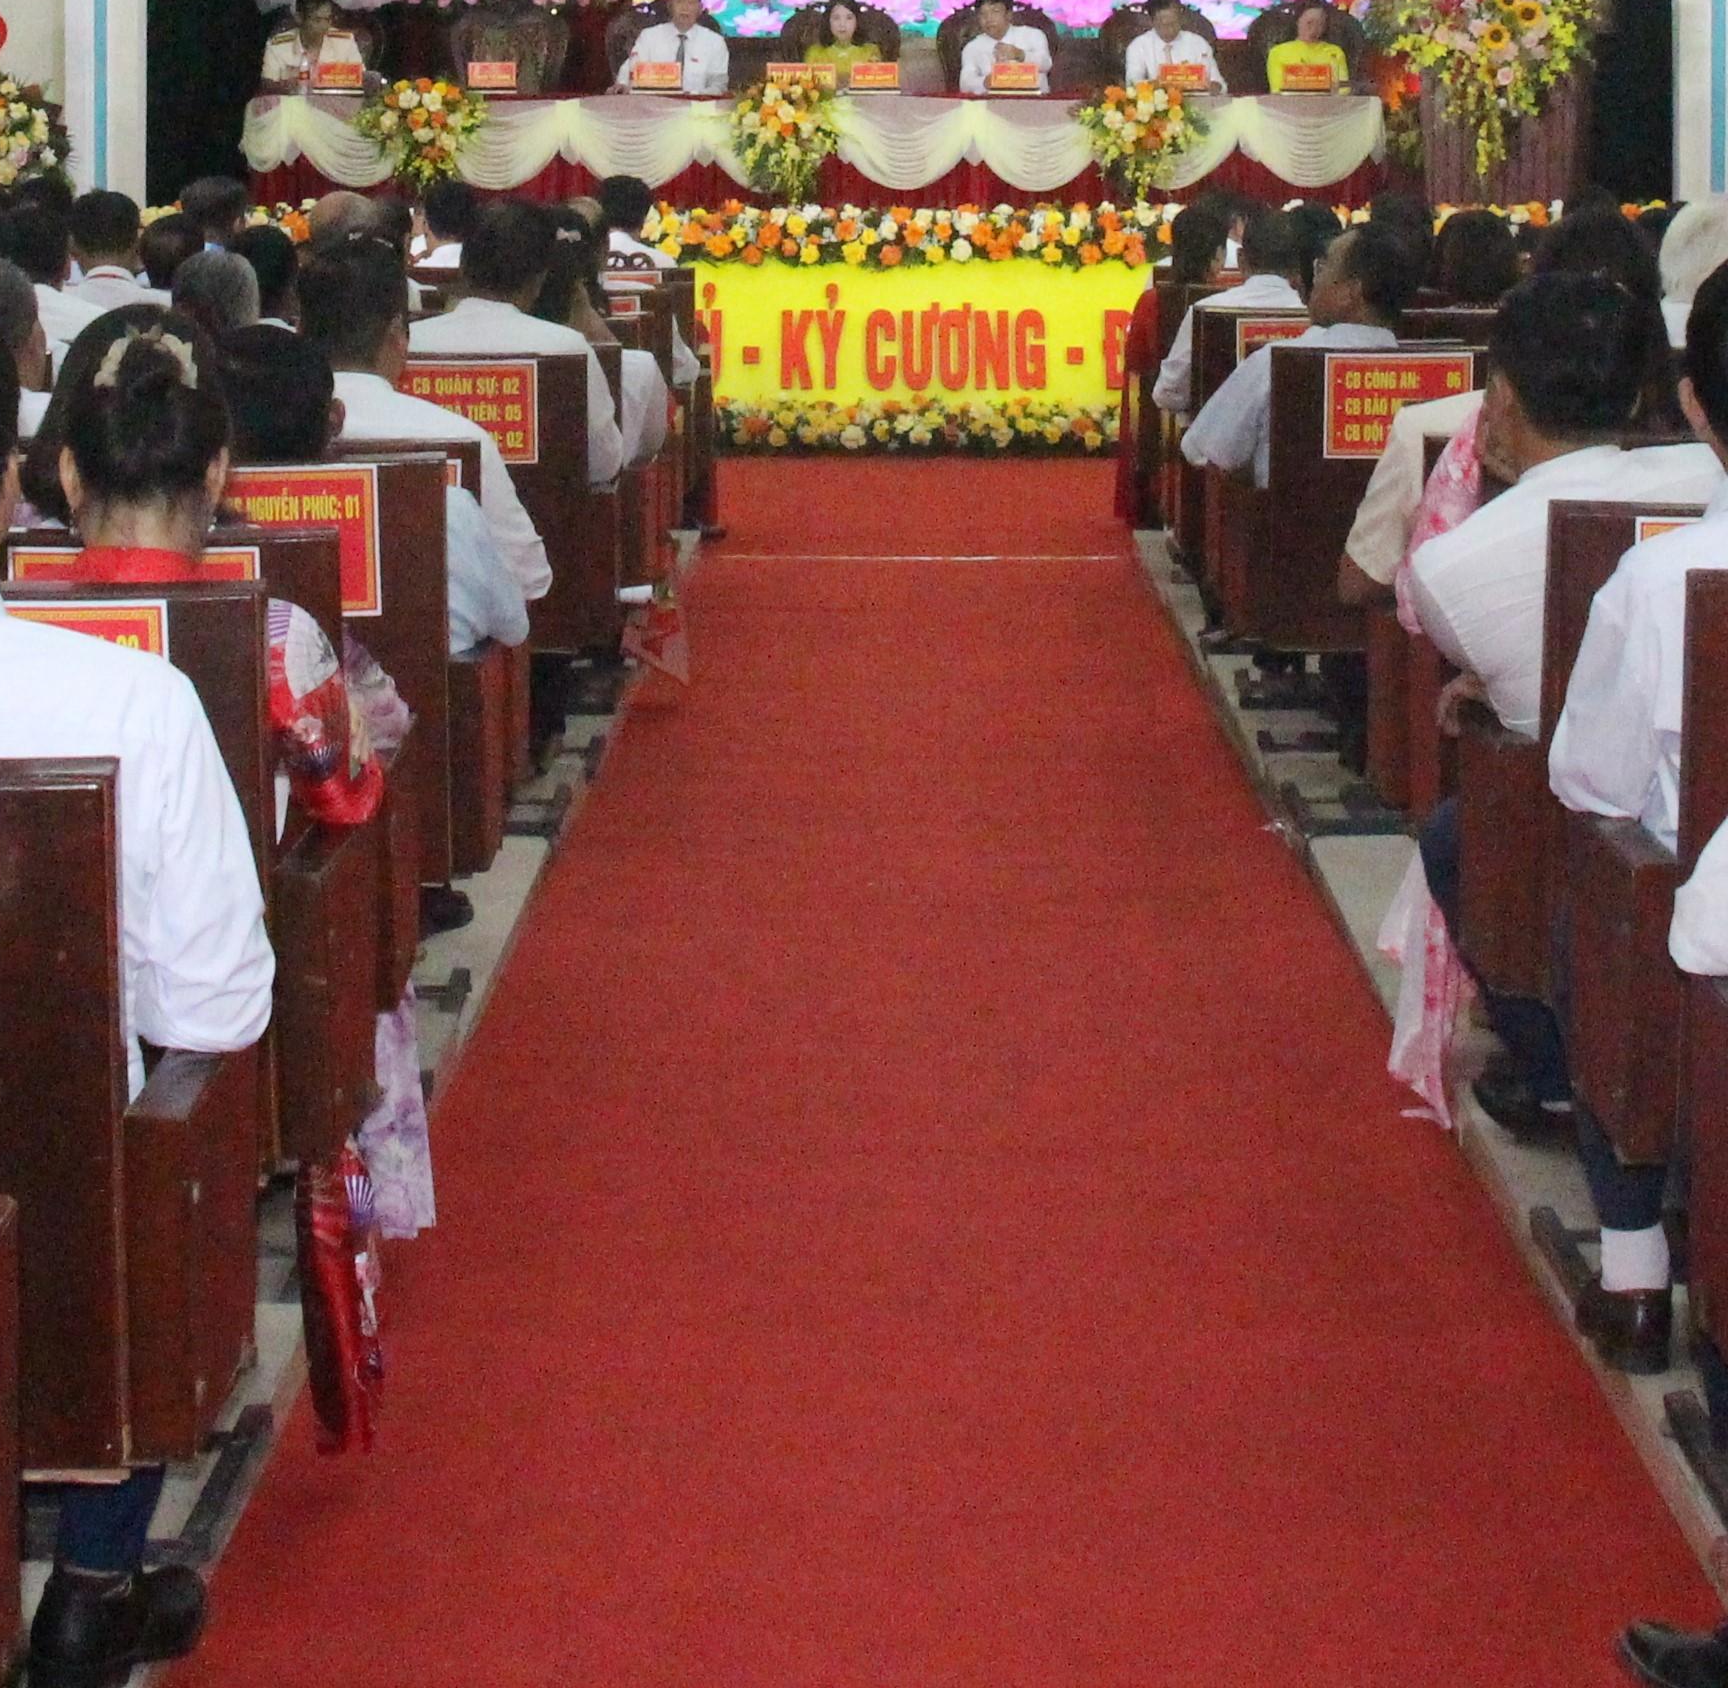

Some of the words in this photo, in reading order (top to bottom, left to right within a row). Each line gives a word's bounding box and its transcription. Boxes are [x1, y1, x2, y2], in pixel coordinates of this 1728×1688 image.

[780, 282, 846, 391] KỶ
[864, 301, 1047, 392] CƯƠNG
[502, 377, 520, 395] 02
[303, 488, 343, 521] PHÚC:
[345, 494, 361, 520] 01
